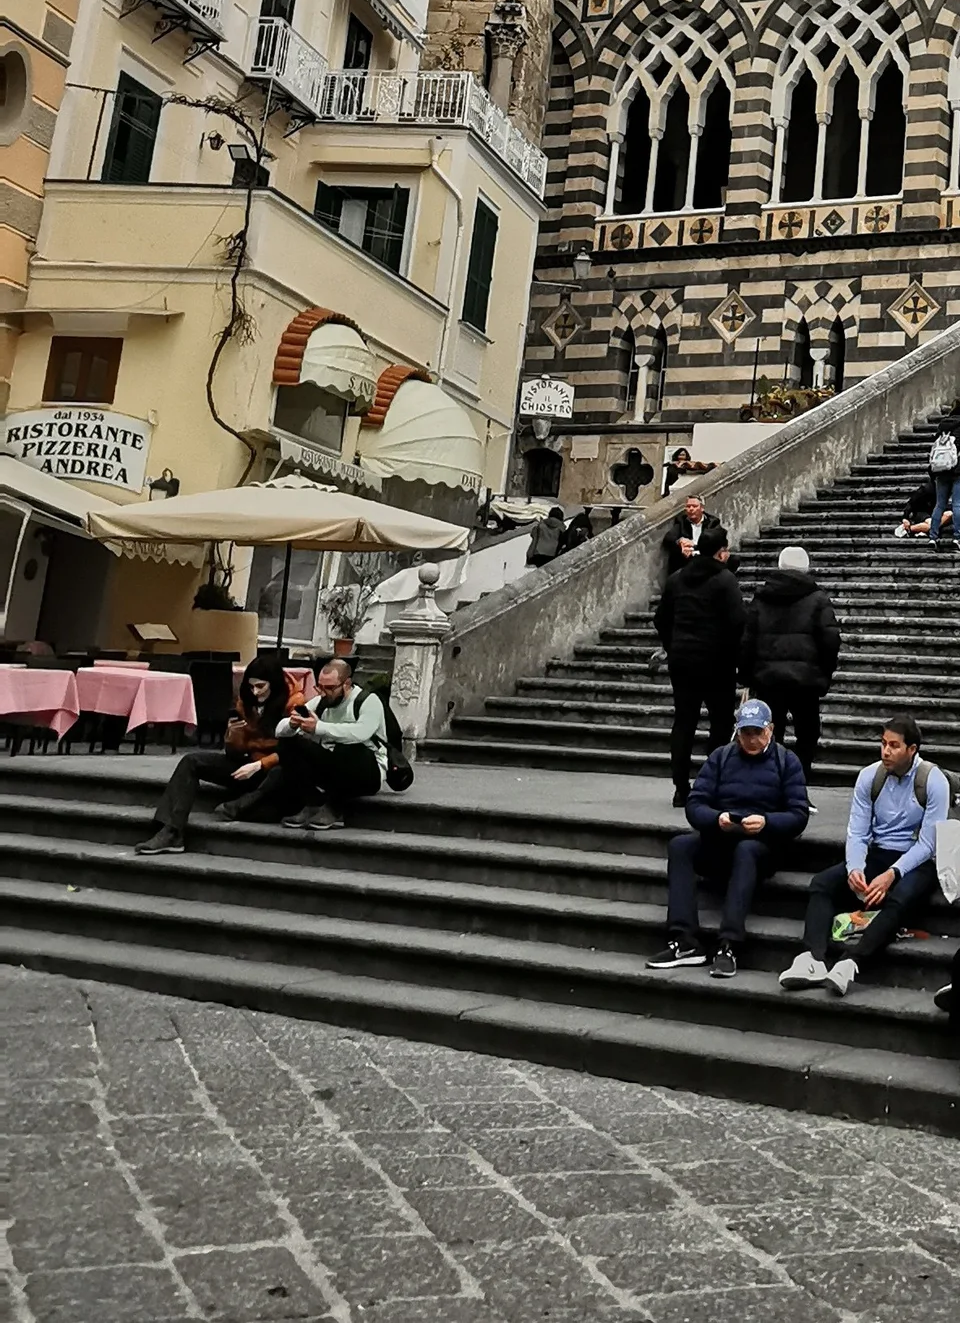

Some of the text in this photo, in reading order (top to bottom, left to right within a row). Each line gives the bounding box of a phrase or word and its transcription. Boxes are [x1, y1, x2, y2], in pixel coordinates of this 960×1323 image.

[524, 381, 570, 404] RISTORANTE
[54, 411, 105, 422] dal 1934
[521, 402, 572, 414] CHIOSTRO
[6, 422, 144, 451] RISTORANTE
[21, 441, 122, 464] PIZZERIA
[39, 459, 129, 484] ANDREA
